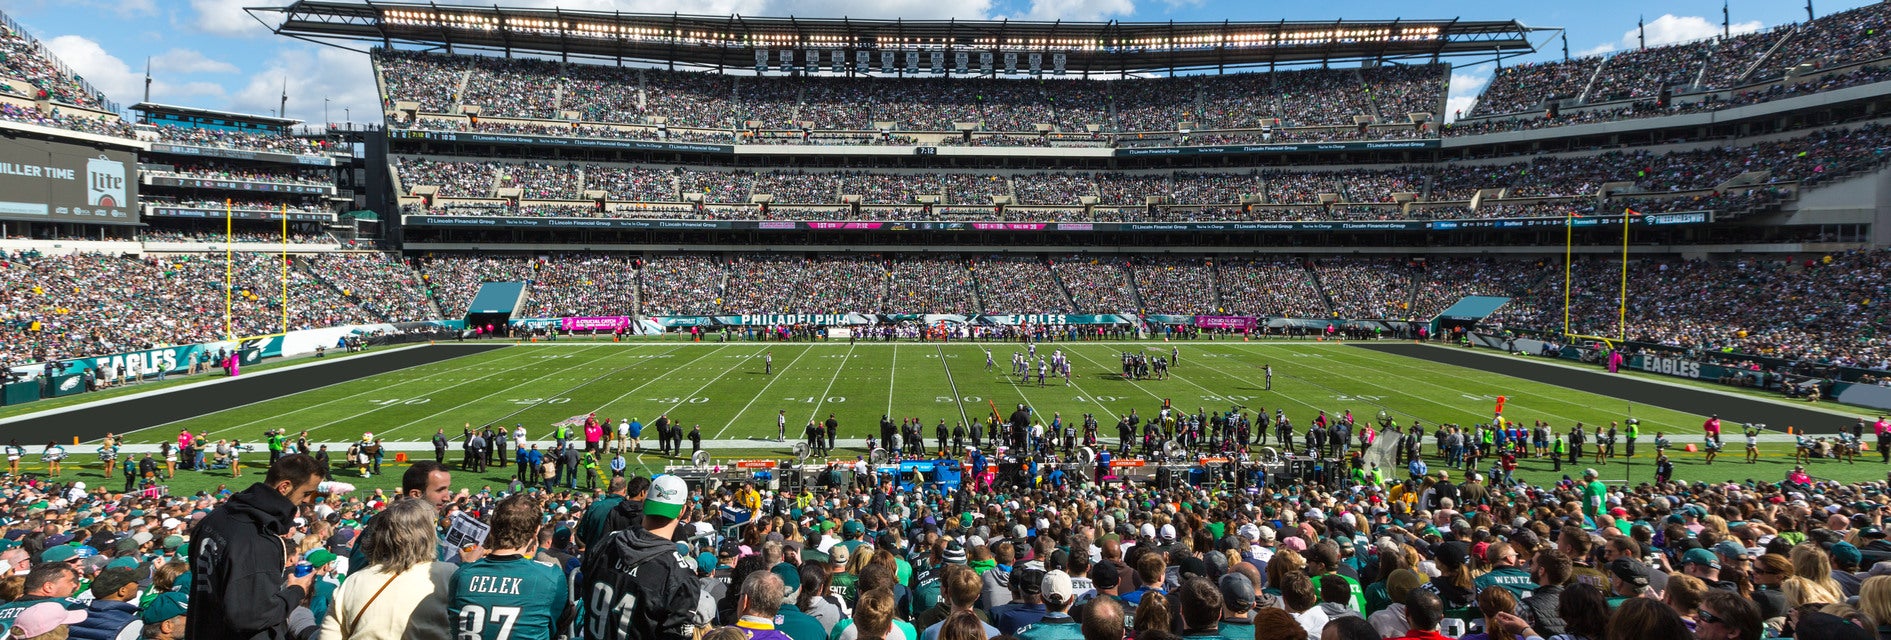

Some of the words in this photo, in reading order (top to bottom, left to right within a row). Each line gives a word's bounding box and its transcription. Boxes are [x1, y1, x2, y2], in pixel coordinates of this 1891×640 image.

[44, 167, 75, 180] TIME
[91, 171, 122, 192] Lite
[742, 315, 850, 325] PHILADELPHIA
[1008, 314, 1066, 325] EAGLES
[96, 348, 177, 381] EAGLES
[1643, 354, 1700, 378] EAGLES
[469, 575, 523, 595] CELEK
[1494, 576, 1532, 584] WENTZ
[459, 604, 522, 640] 87
